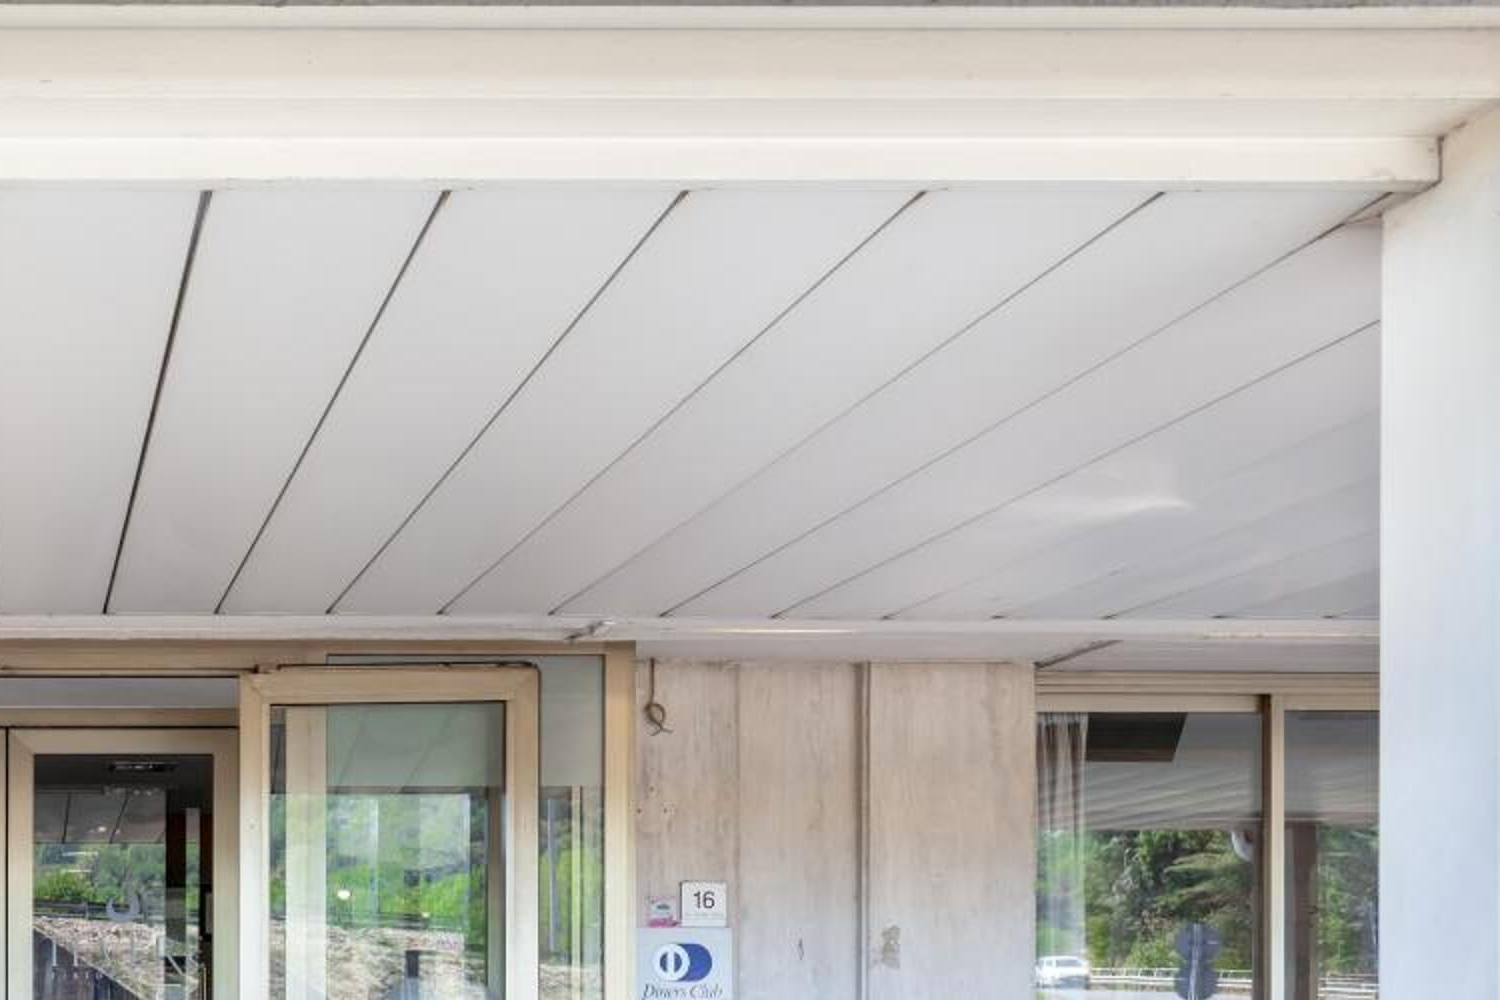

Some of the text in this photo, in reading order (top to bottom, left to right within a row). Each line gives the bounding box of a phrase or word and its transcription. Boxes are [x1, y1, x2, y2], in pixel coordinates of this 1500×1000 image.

[693, 890, 716, 910] 16
[643, 983, 723, 999] Diners Club
